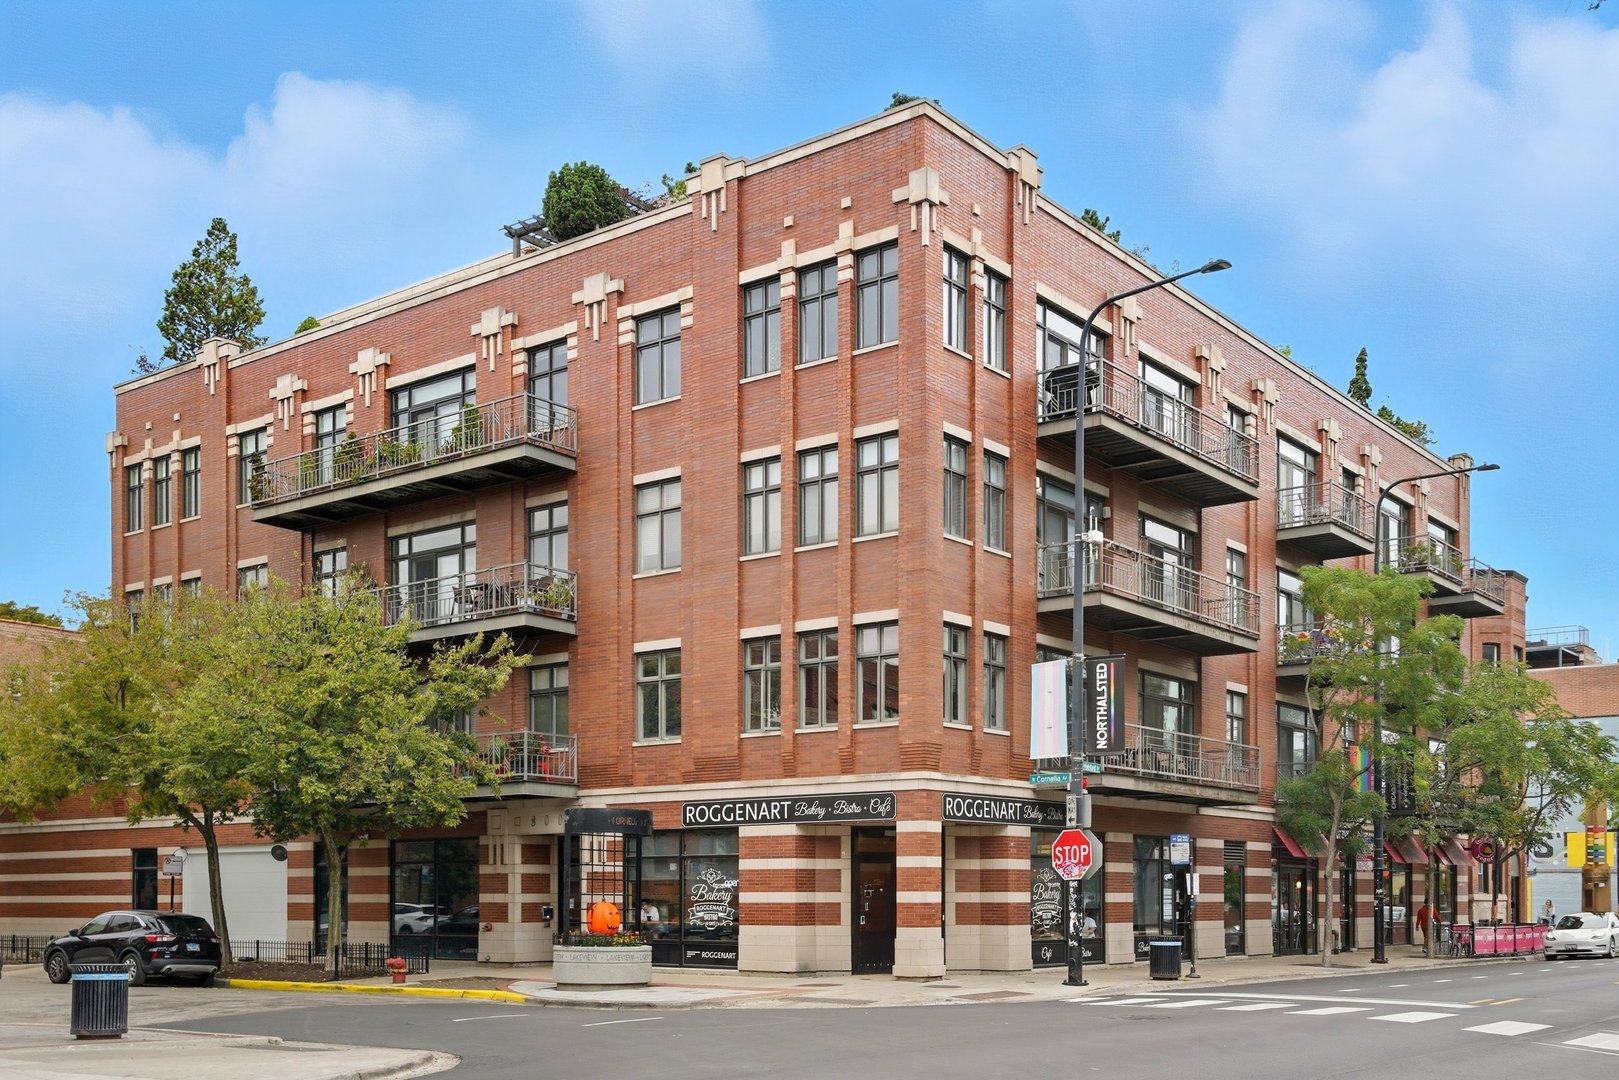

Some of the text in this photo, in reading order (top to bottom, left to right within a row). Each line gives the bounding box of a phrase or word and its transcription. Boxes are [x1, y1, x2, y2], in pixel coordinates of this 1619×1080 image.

[1096, 662, 1108, 749] NORTHALSTED
[1036, 775, 1060, 783] Cornelia
[686, 797, 891, 823] ROGGENART Bakery Bistro Café
[946, 797, 1022, 820] ROGGENART
[1023, 805, 1043, 823] Bakery
[1055, 845, 1089, 864] STOP
[691, 882, 733, 905] Bakery
[1033, 882, 1060, 904] Bakery
[696, 904, 726, 912] ROGGENART
[701, 951, 737, 959] ROGGENART
